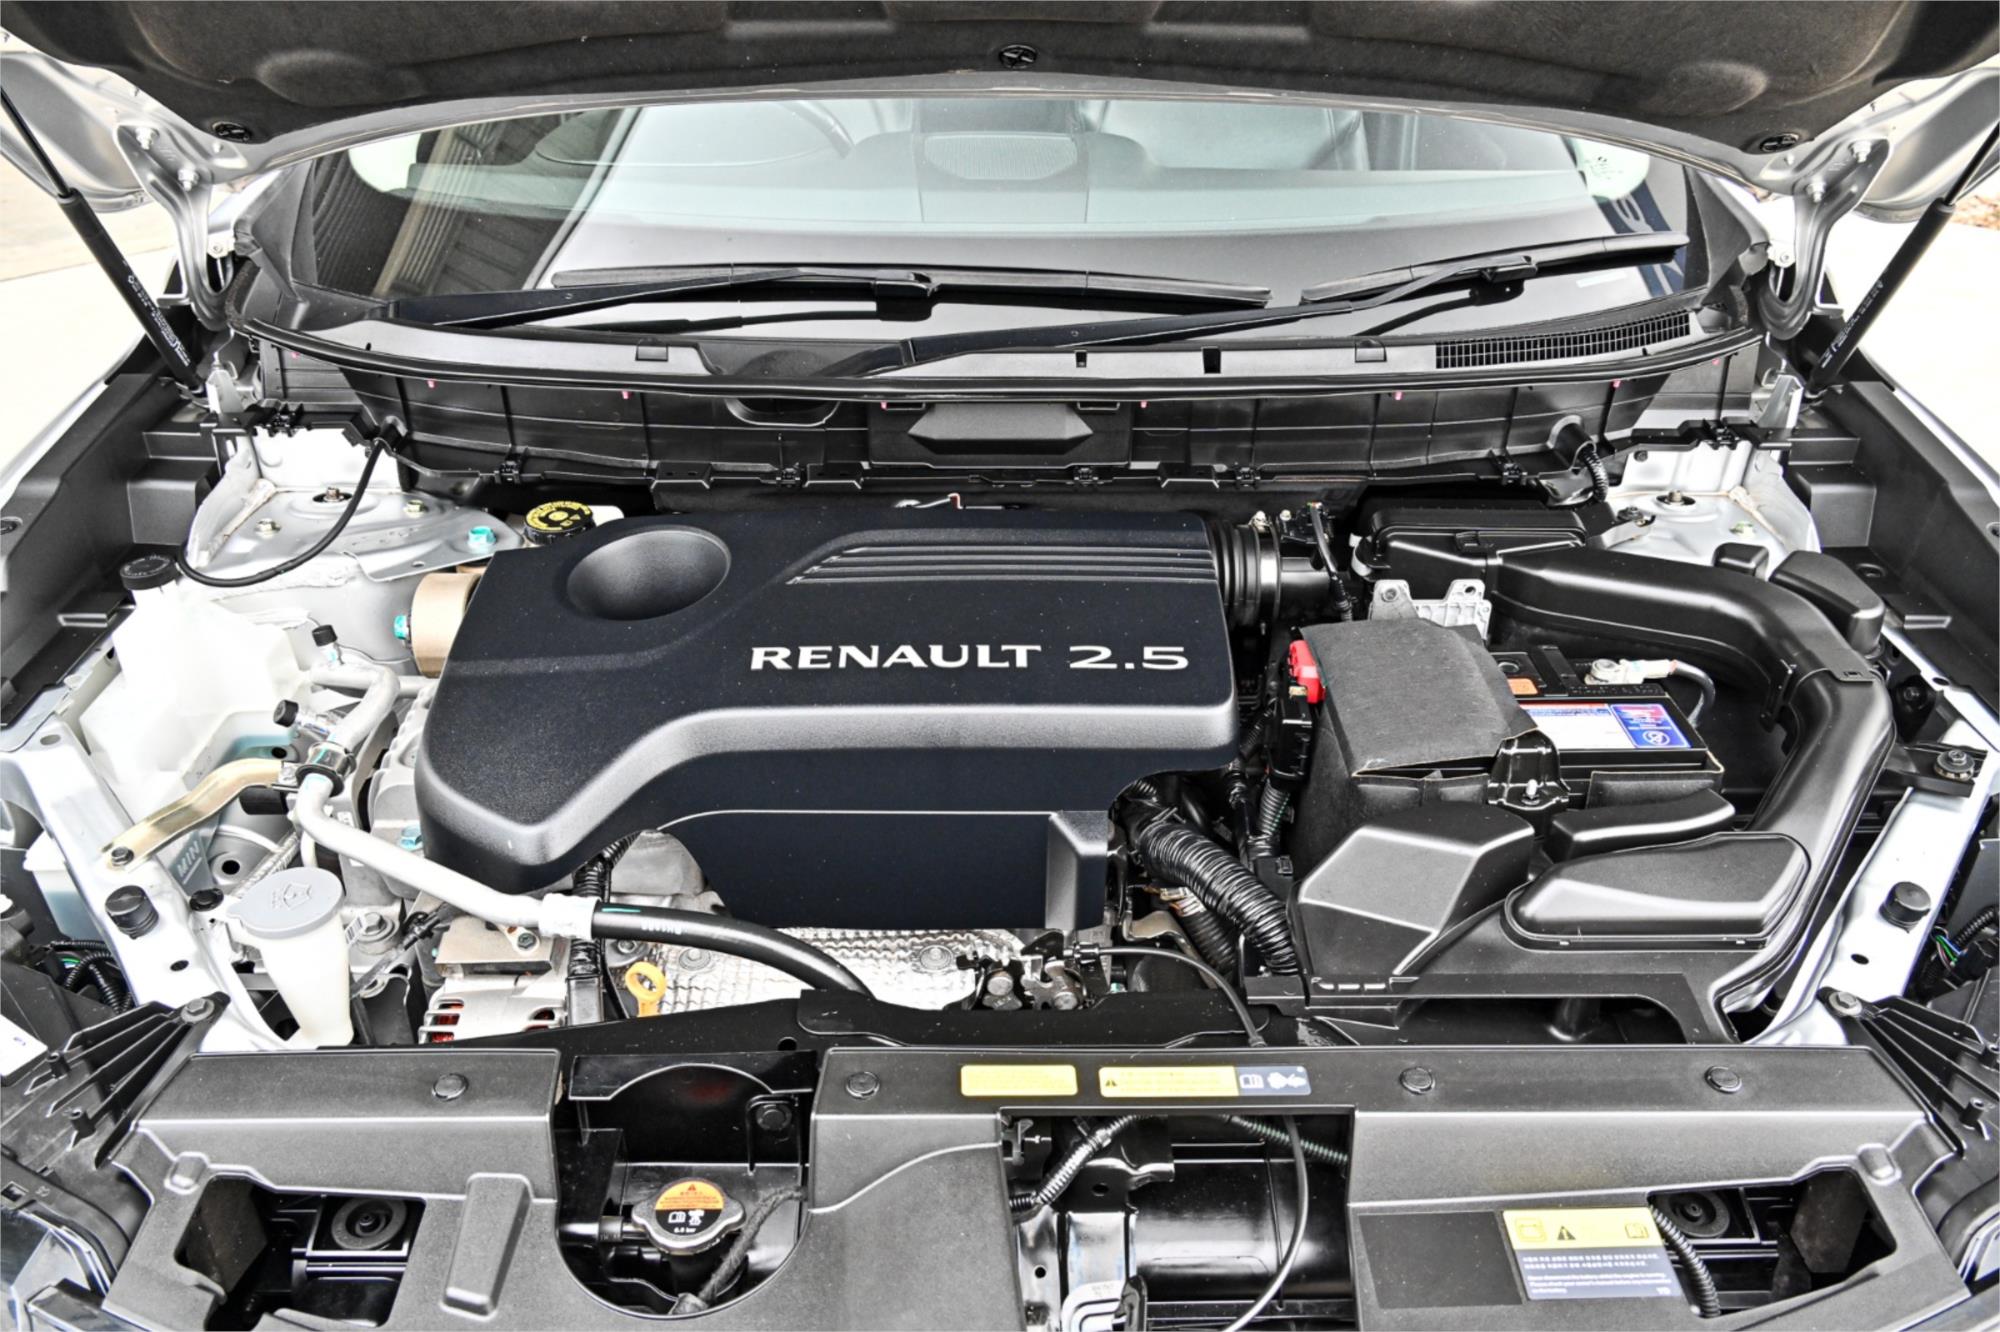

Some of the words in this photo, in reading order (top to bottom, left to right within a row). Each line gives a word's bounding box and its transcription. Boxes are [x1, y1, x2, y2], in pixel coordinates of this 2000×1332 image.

[750, 644, 1042, 670] RENAULT
[1069, 646, 1189, 670] 2.5
[176, 840, 202, 878] MIN
